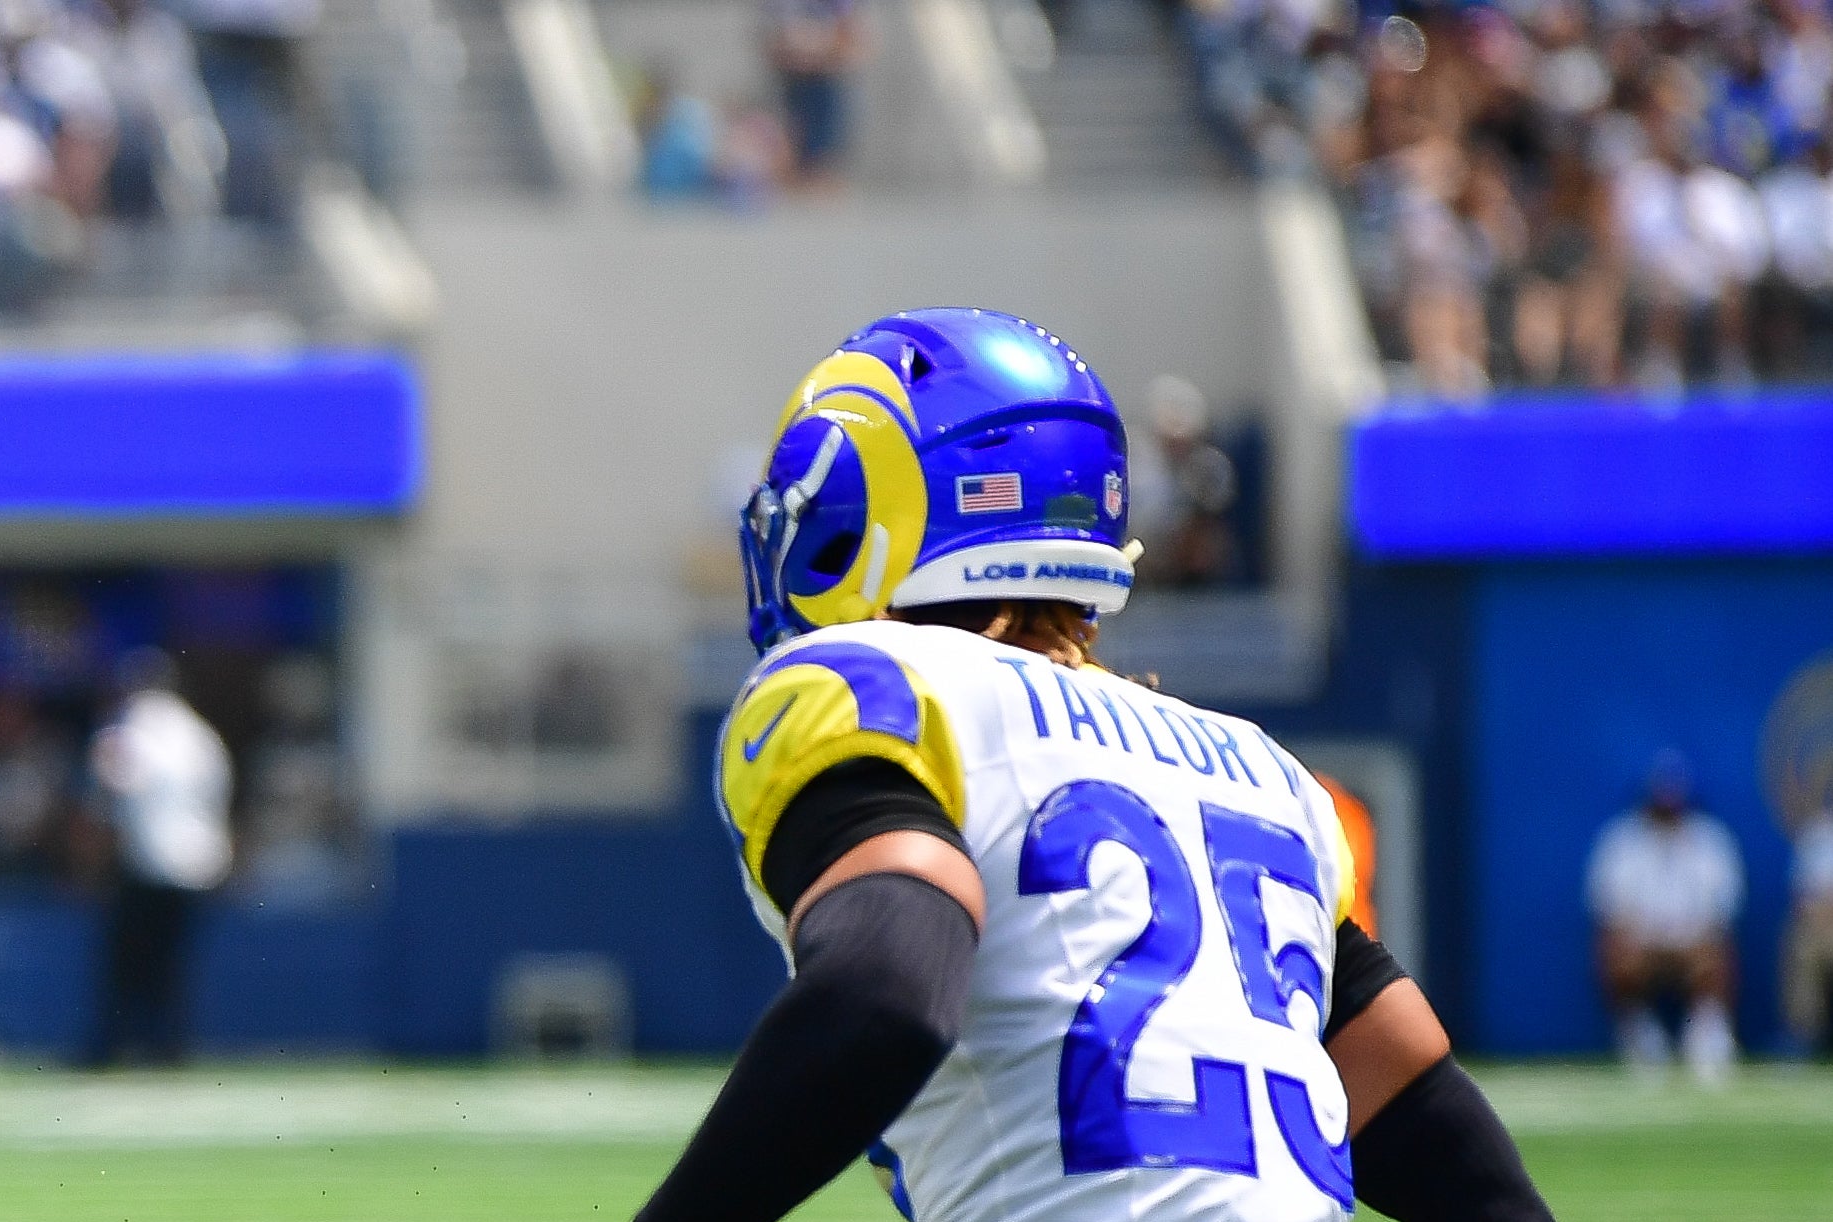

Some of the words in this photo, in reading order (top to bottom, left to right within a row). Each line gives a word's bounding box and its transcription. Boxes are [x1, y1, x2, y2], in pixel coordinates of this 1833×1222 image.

[964, 563, 1026, 582] LOS
[994, 656, 1261, 788] TAYLOR
[1019, 778, 1354, 1213] 25
